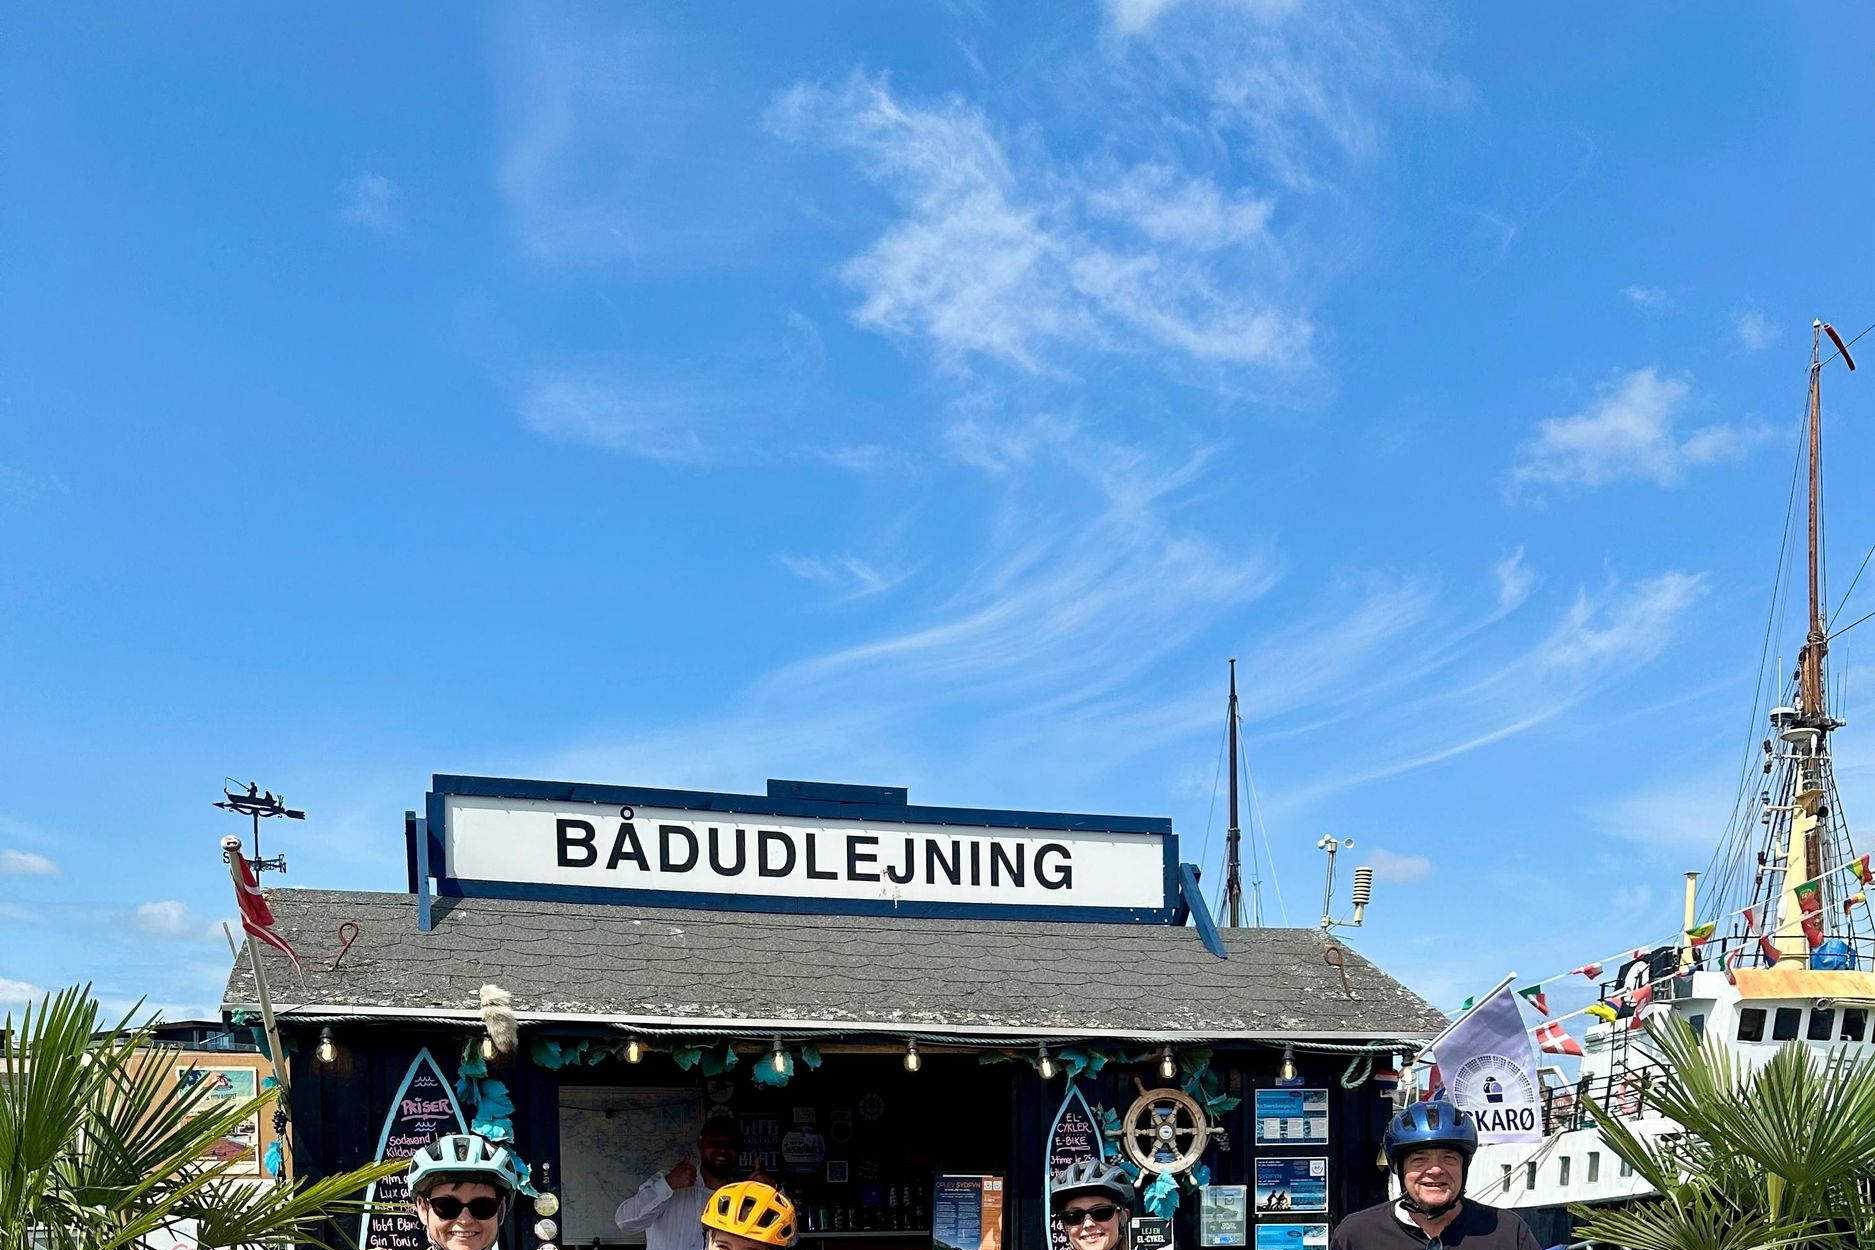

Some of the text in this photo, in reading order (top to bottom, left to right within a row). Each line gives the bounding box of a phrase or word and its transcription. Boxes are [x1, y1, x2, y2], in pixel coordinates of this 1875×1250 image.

[555, 805, 1073, 890] BÅDUDLEJNING
[1066, 1113, 1082, 1122] EL-
[1057, 1123, 1093, 1133] CYKLER
[389, 1133, 431, 1146] Sodavand
[1055, 1137, 1087, 1146] E-BIKE
[386, 1146, 418, 1158] Kildeva
[738, 1152, 779, 1167] BOAT
[372, 1218, 393, 1232] 1664
[1141, 1227, 1152, 1235] LEJ
[370, 1233, 419, 1248] Gin Tonic
[1052, 1232, 1057, 1243] 5
[1136, 1235, 1165, 1243] EL-CYKEL
